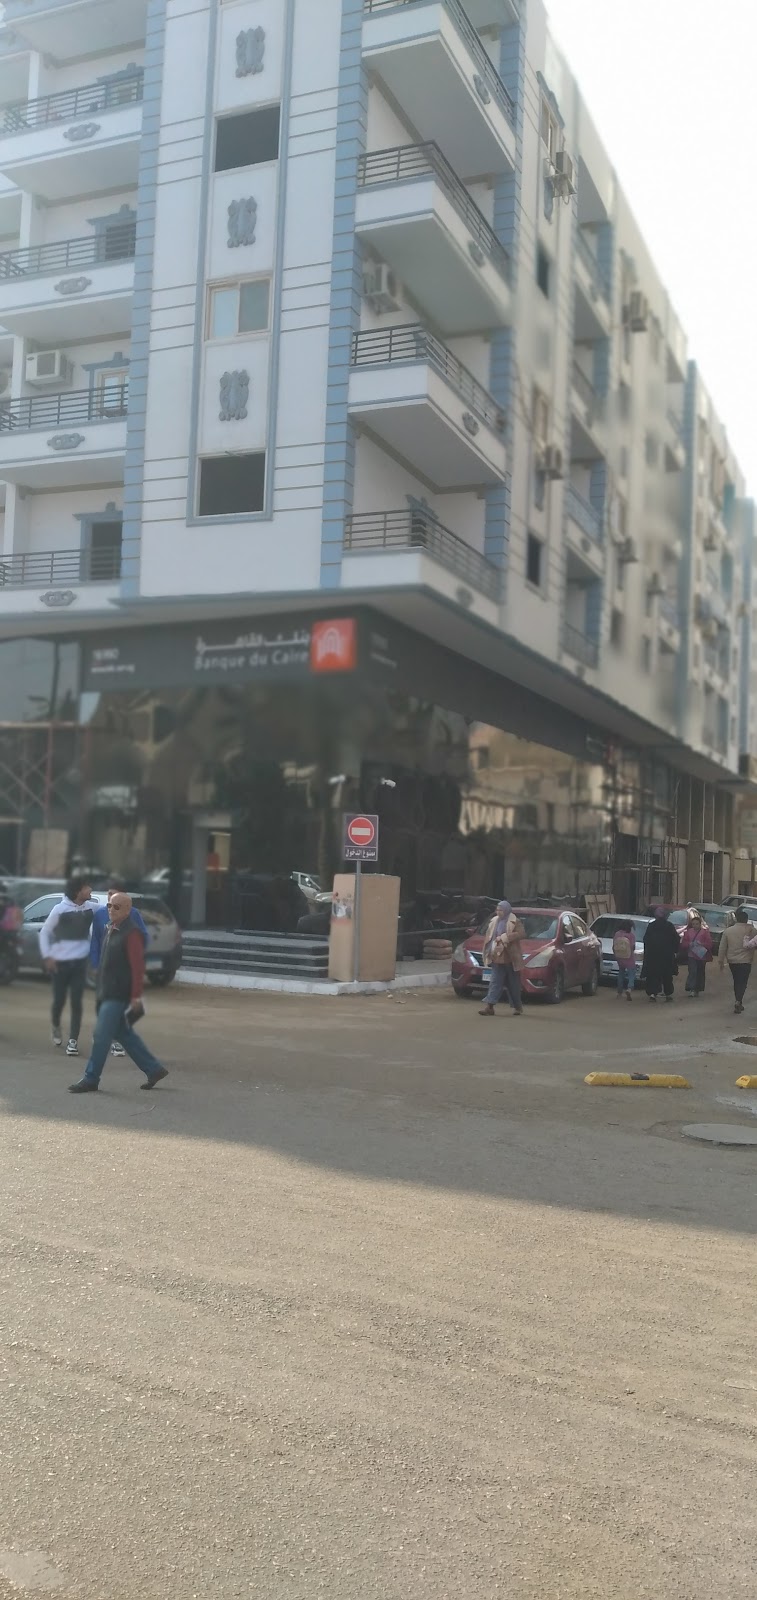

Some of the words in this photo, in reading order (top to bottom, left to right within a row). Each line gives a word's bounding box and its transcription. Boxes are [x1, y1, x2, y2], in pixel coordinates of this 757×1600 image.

[194, 654, 246, 672] Banque
[249, 651, 269, 667] du
[272, 648, 310, 665] Caire
[345, 848, 362, 858] الدخول
[362, 849, 375, 858] ممنوع
